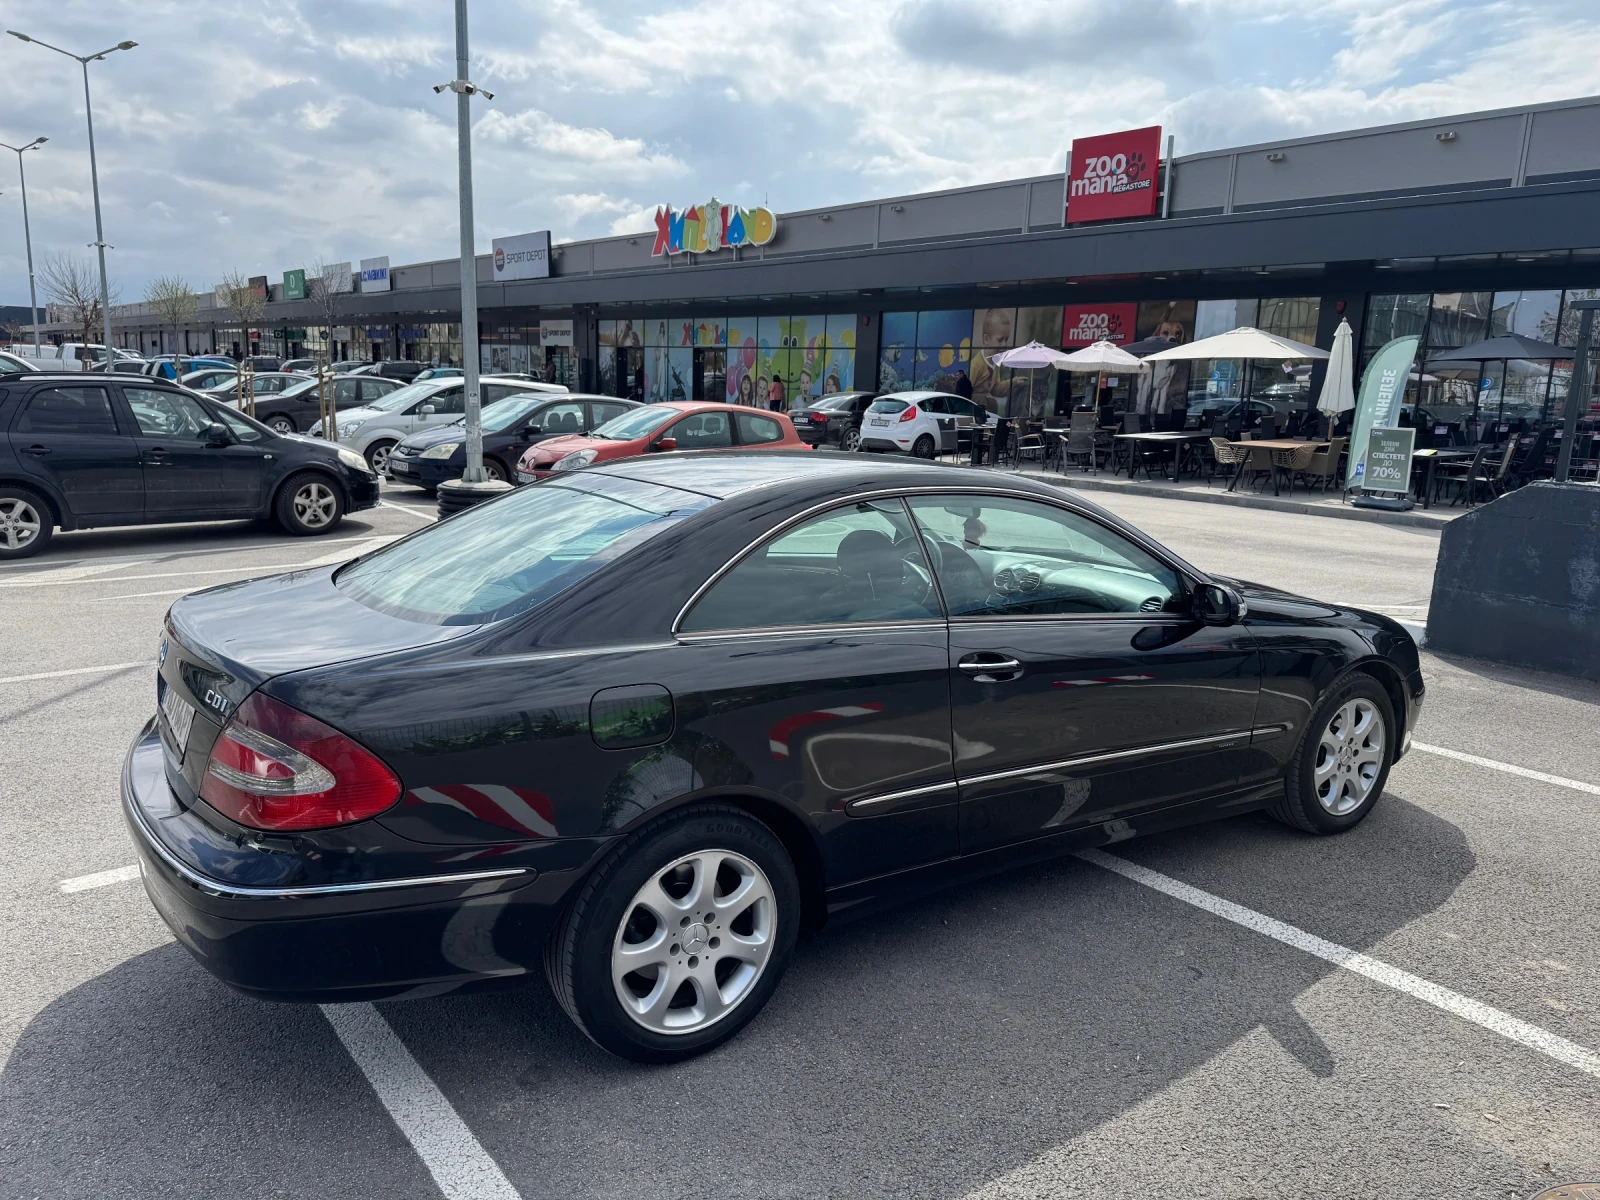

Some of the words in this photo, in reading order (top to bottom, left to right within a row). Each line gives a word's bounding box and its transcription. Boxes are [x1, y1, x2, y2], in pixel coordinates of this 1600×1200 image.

[1071, 173, 1127, 196] mania
[1113, 179, 1150, 194] MEGASTORE
[506, 252, 525, 264] SPORT
[526, 249, 546, 261] DEPOT
[289, 274, 296, 289] D
[1069, 327, 1109, 340] mania
[1372, 452, 1406, 461] СПЕСТЕТЕ
[1372, 467, 1401, 479] 70%
[205, 689, 228, 712] CDI
